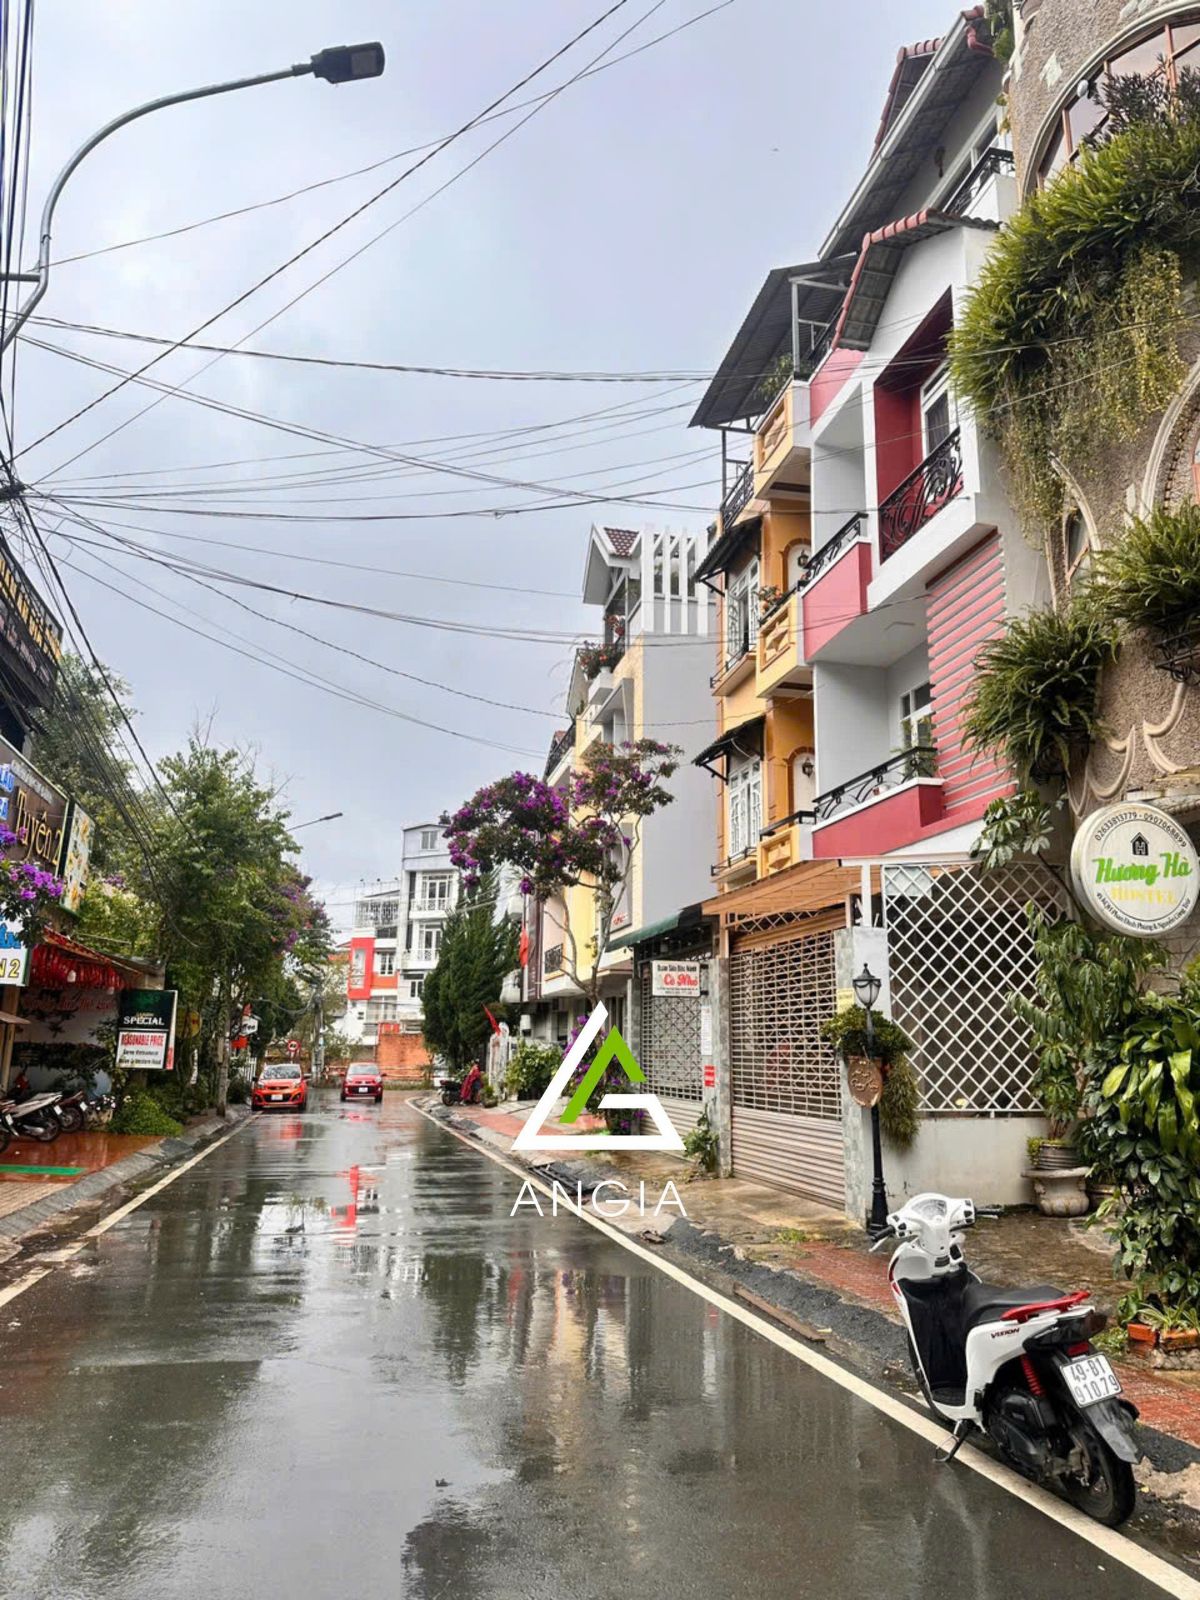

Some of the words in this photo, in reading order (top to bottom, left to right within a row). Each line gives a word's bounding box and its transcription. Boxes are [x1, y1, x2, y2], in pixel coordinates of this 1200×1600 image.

[1159, 851, 1192, 878] Hà
[8, 958, 21, 979] 2
[123, 1015, 165, 1026] SPECIAL
[1070, 1356, 1107, 1384] 49-B1
[1074, 1374, 1121, 1404] 910.79
